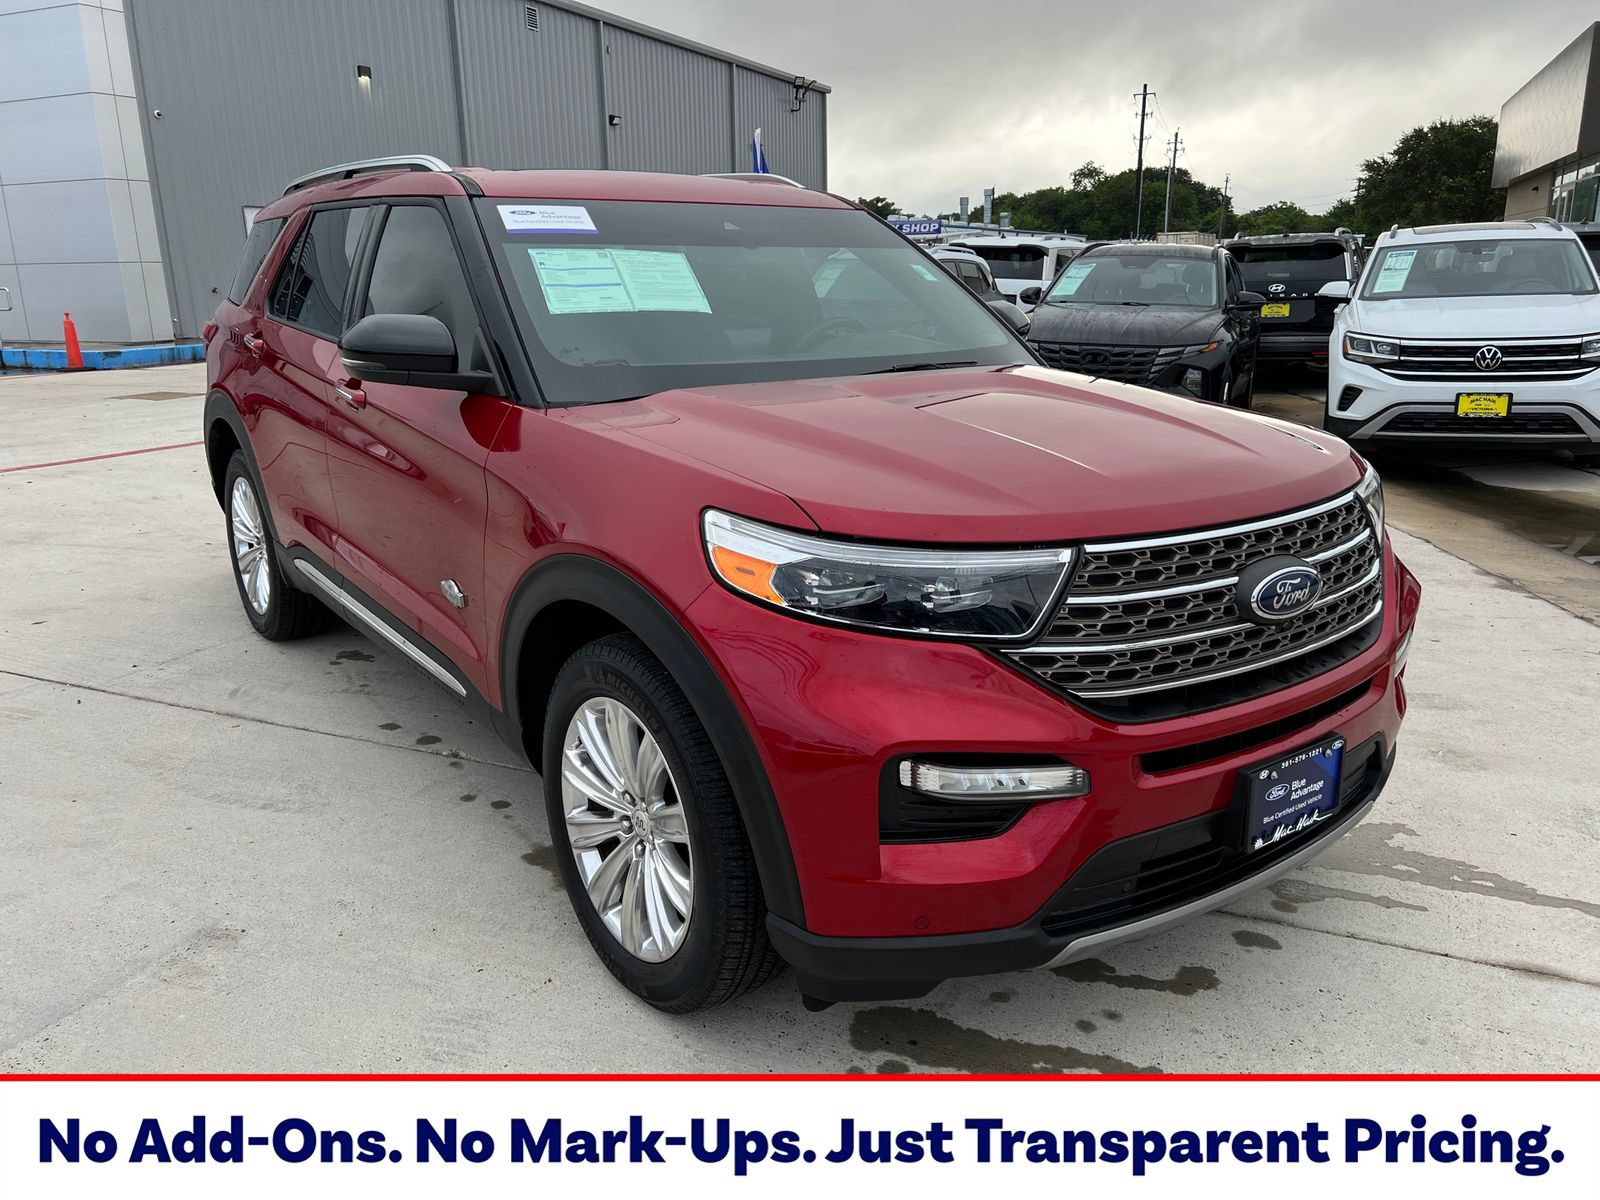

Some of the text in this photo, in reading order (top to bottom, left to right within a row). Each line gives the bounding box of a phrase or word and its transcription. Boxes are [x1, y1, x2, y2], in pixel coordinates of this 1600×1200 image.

[901, 223, 939, 233] SHOP
[1273, 577, 1311, 610] Ford
[605, 672, 662, 735] MICHELIN
[1290, 780, 1325, 801] Advantage
[1291, 778, 1307, 791] Blue
[1263, 793, 1323, 824] Blue Certified Used Vehicle
[1272, 823, 1296, 843] Mac
